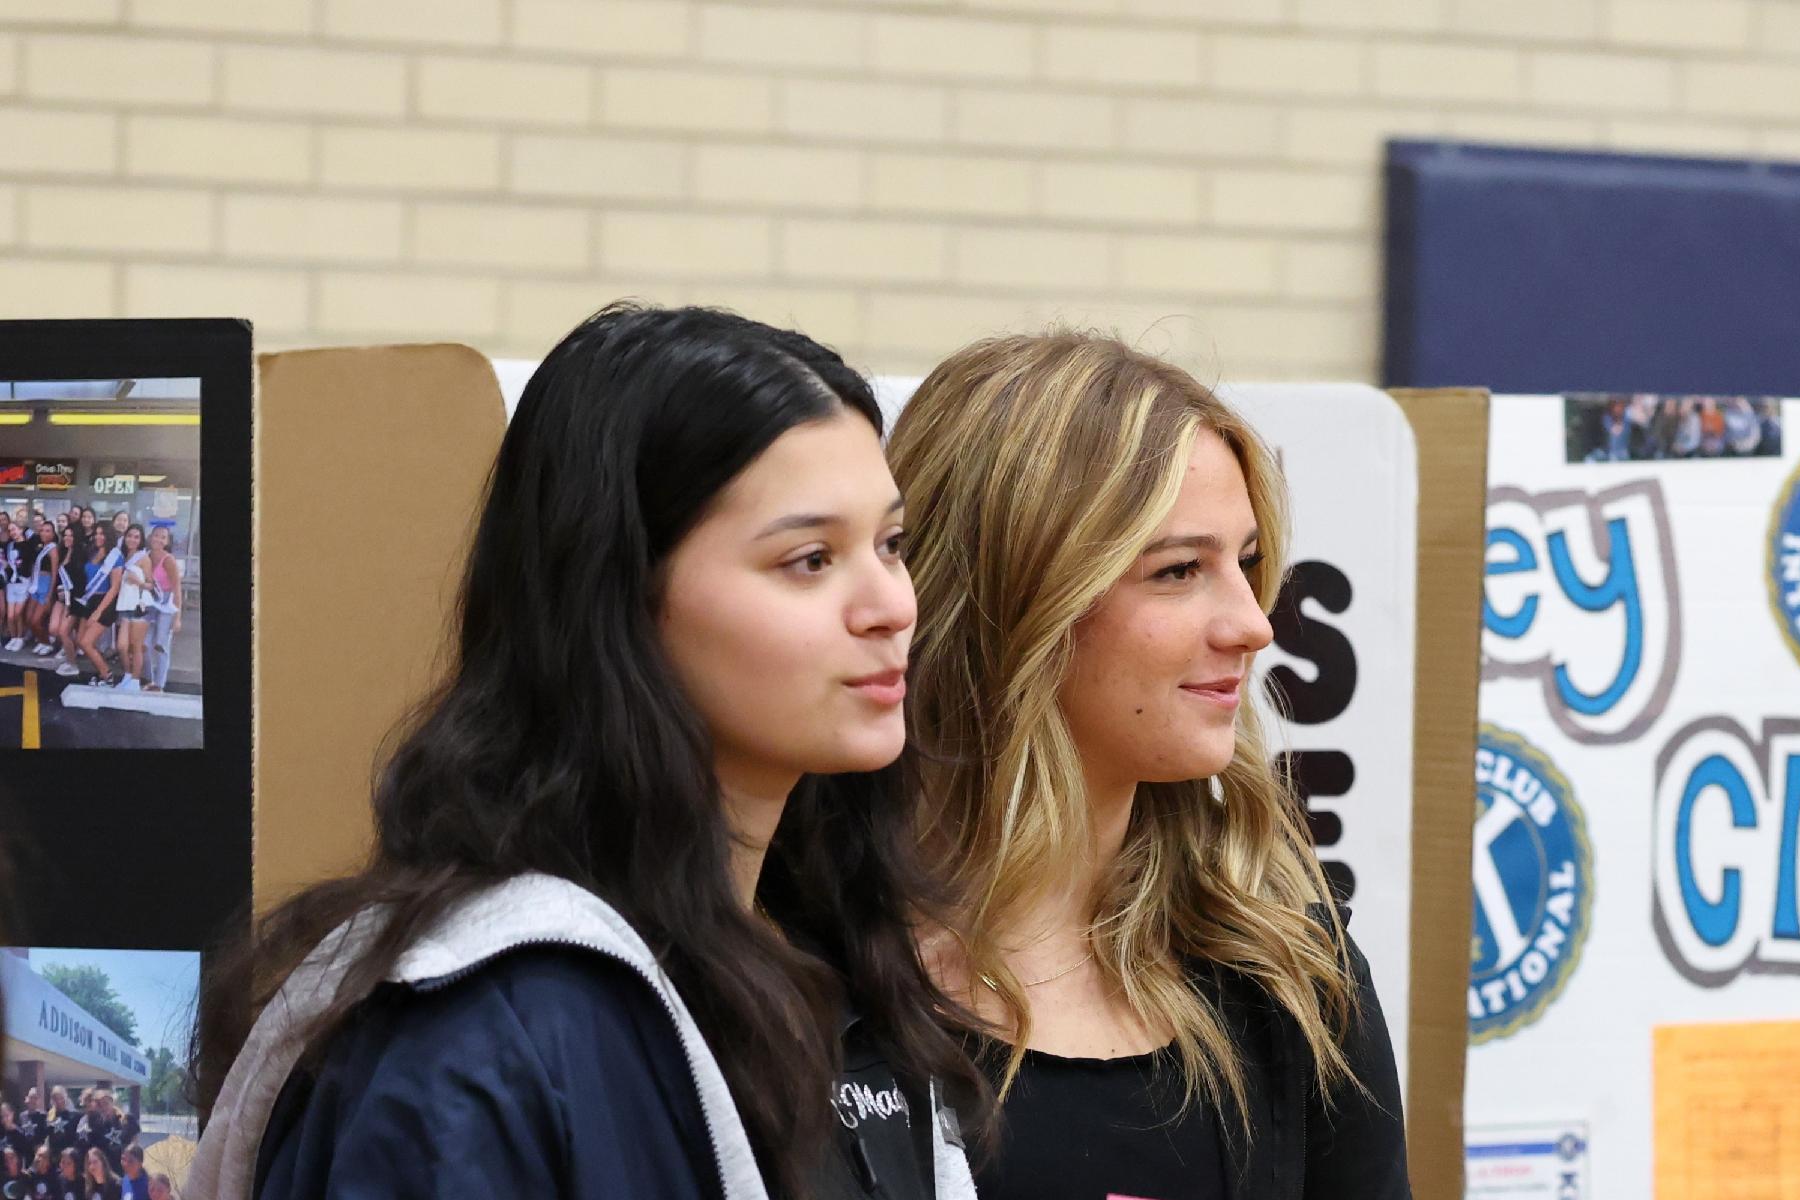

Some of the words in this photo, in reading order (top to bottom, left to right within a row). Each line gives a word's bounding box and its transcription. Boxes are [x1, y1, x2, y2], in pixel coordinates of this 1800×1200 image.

[94, 477, 135, 494] OPEN
[1482, 505, 1657, 727] ey
[39, 999, 93, 1051] ADDISON
